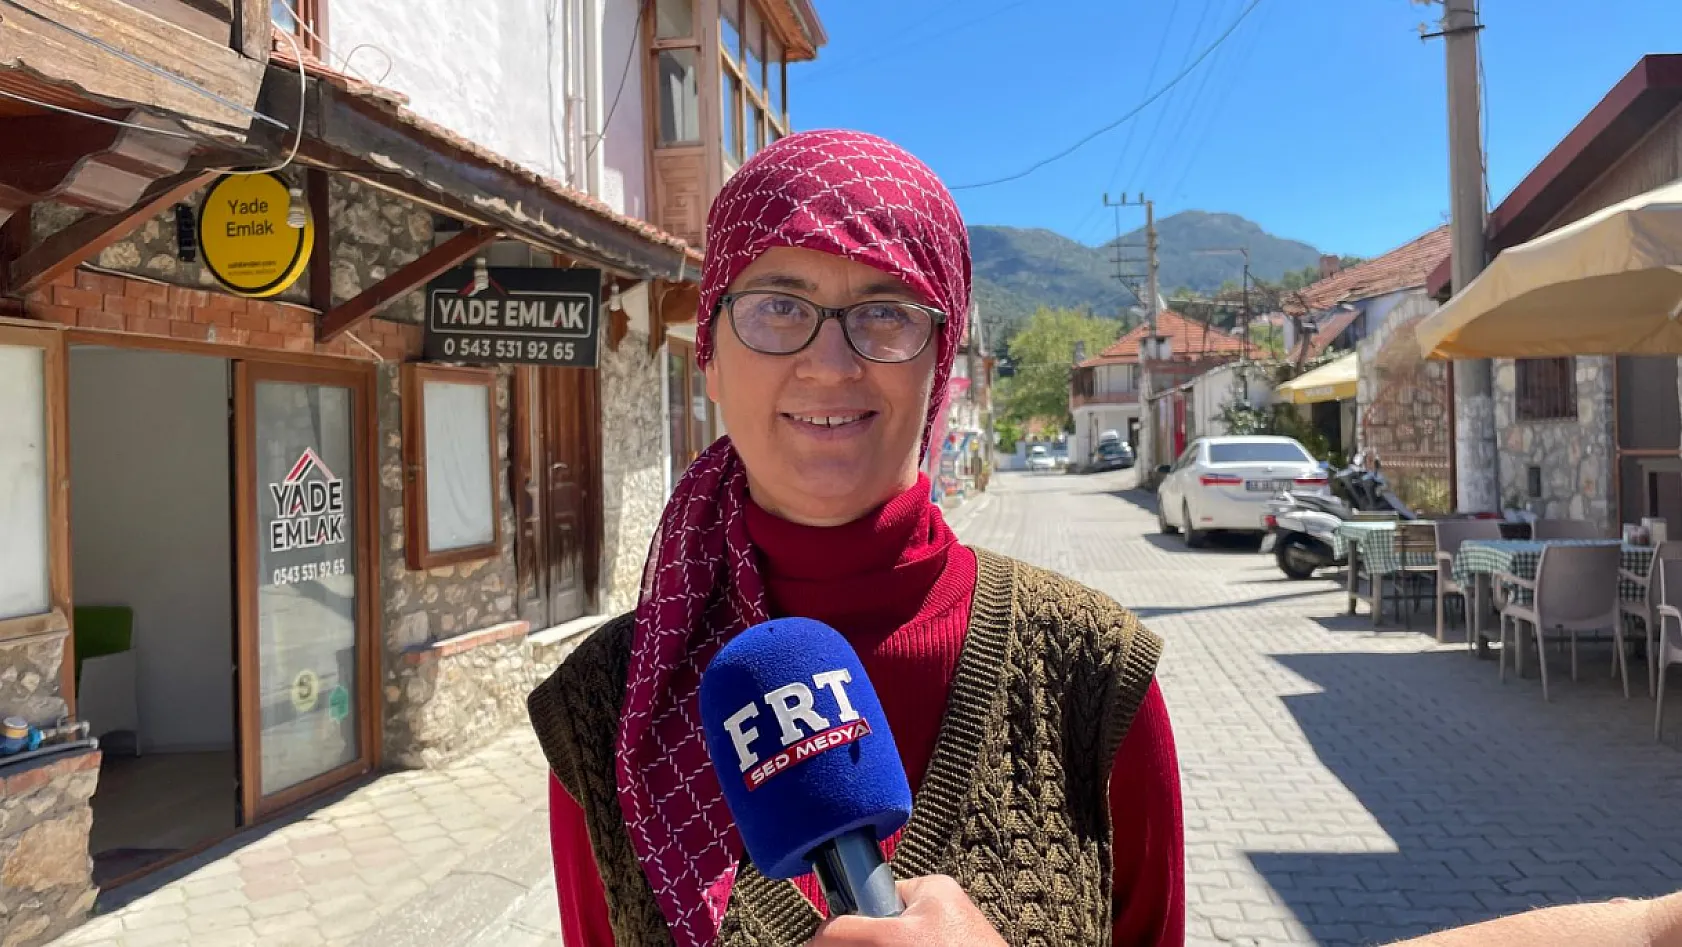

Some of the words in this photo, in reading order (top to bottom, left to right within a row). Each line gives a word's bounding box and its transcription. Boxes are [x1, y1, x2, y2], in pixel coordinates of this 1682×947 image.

[227, 198, 268, 215] Yade
[226, 220, 274, 237] Emlak
[438, 298, 500, 326] YADE
[505, 300, 585, 329] EMLAK
[444, 338, 456, 356] 0
[460, 338, 490, 358] 543
[496, 340, 522, 359] 531
[527, 341, 548, 360] 92
[553, 342, 575, 361] 65
[269, 479, 343, 518] YADE
[271, 514, 344, 552] EMLAK
[273, 566, 300, 586] 0543
[301, 563, 318, 582] 531
[319, 561, 332, 579] 92
[333, 558, 345, 575] 65
[723, 667, 861, 773] FRT
[750, 754, 791, 786] SED
[796, 723, 871, 760] MEDYA
